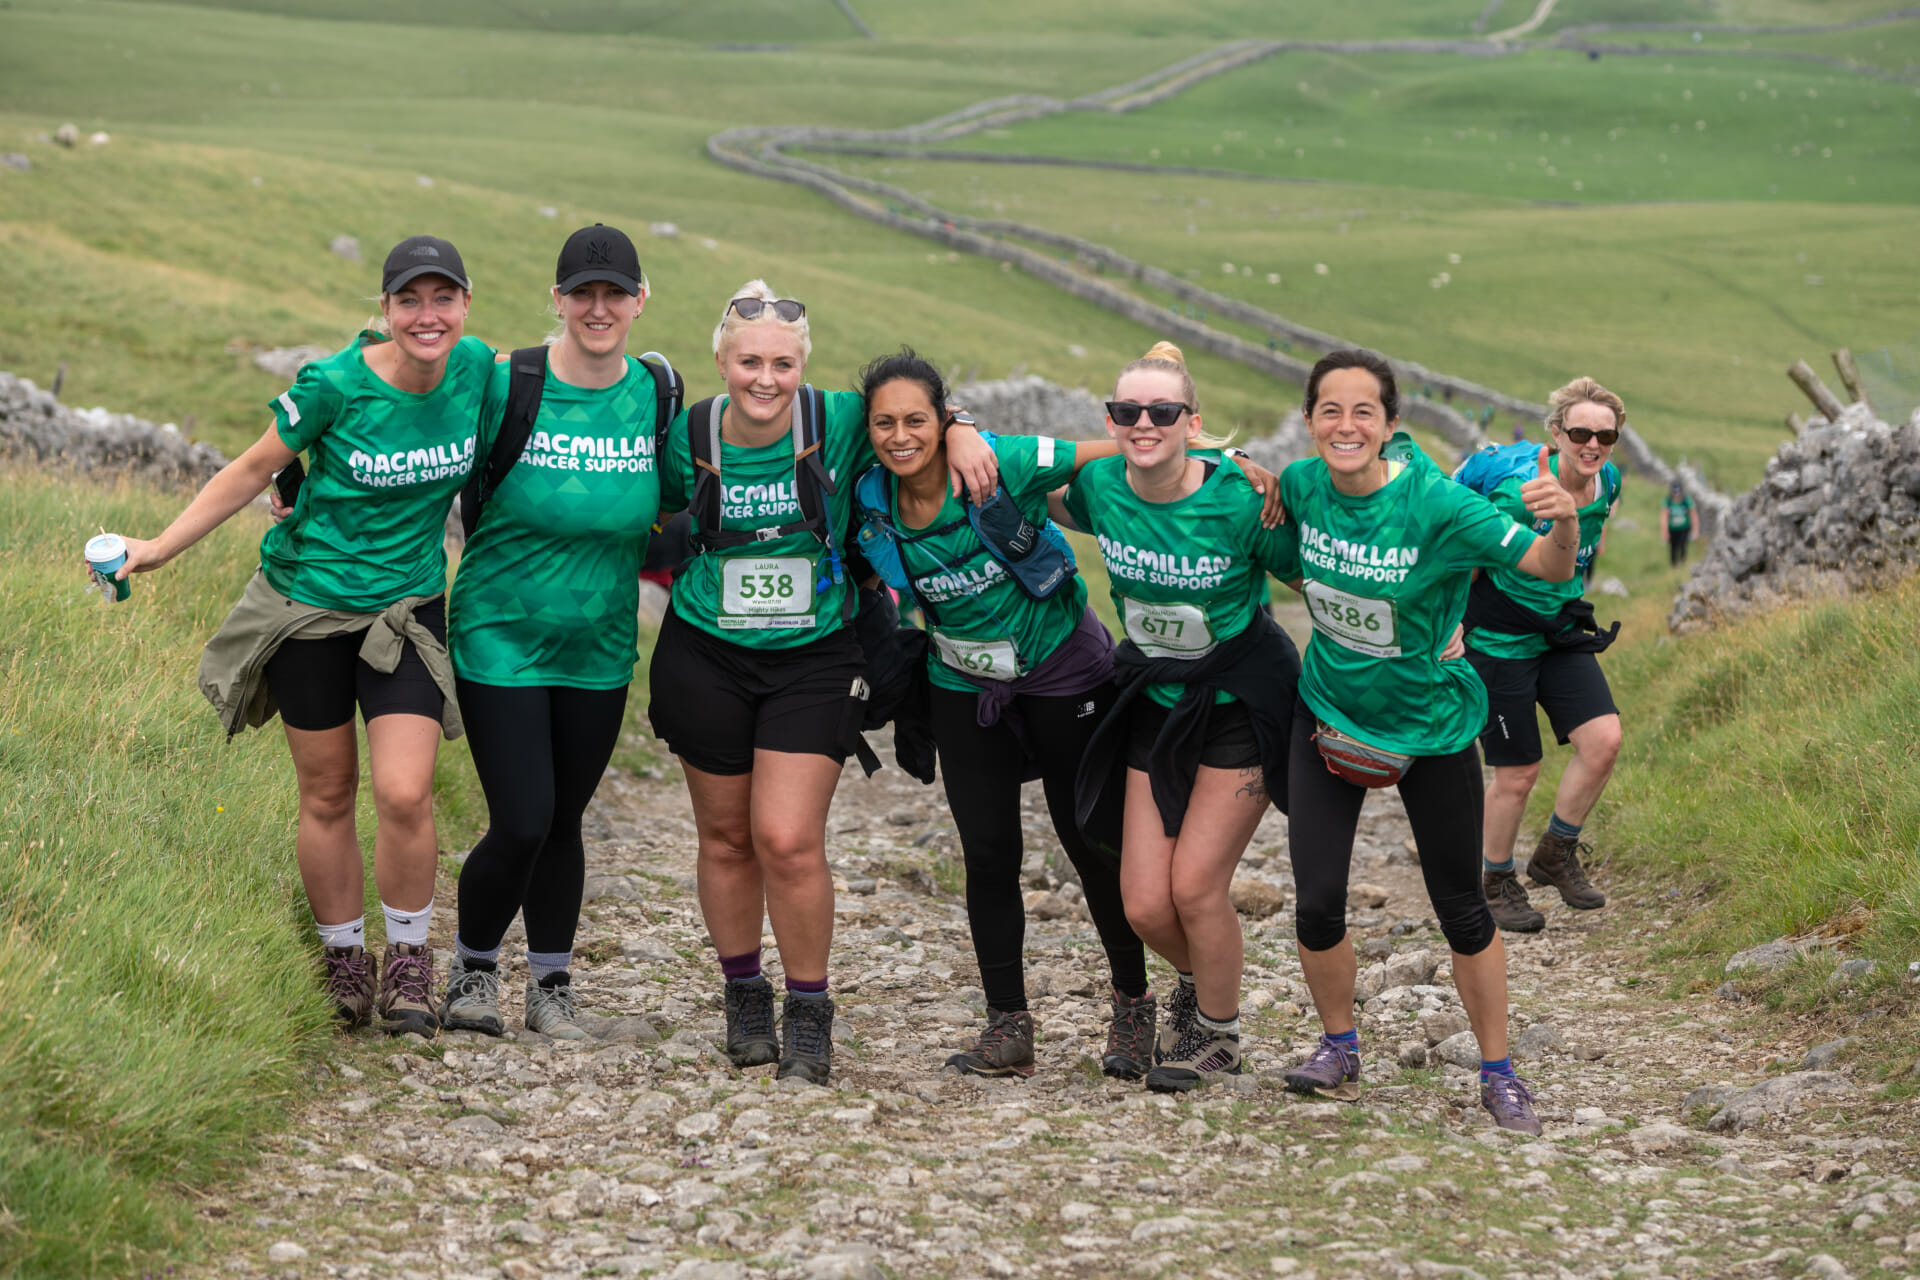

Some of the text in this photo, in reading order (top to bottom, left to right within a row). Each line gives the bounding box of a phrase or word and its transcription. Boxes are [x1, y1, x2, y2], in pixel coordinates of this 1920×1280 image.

[348, 434, 477, 473] MACMILLA
[517, 451, 653, 472] ANCER SUPPORT
[353, 469, 416, 487] CANCER
[758, 501, 802, 516] SUPP
[1097, 533, 1231, 577] MACMILLAN
[1102, 553, 1223, 590] ANCER SUPPORT
[1338, 561, 1409, 583] SUPPORT
[740, 574, 794, 598] 538
[1316, 598, 1380, 631] 1386
[1141, 617, 1184, 638] 677
[952, 650, 996, 673] 162
